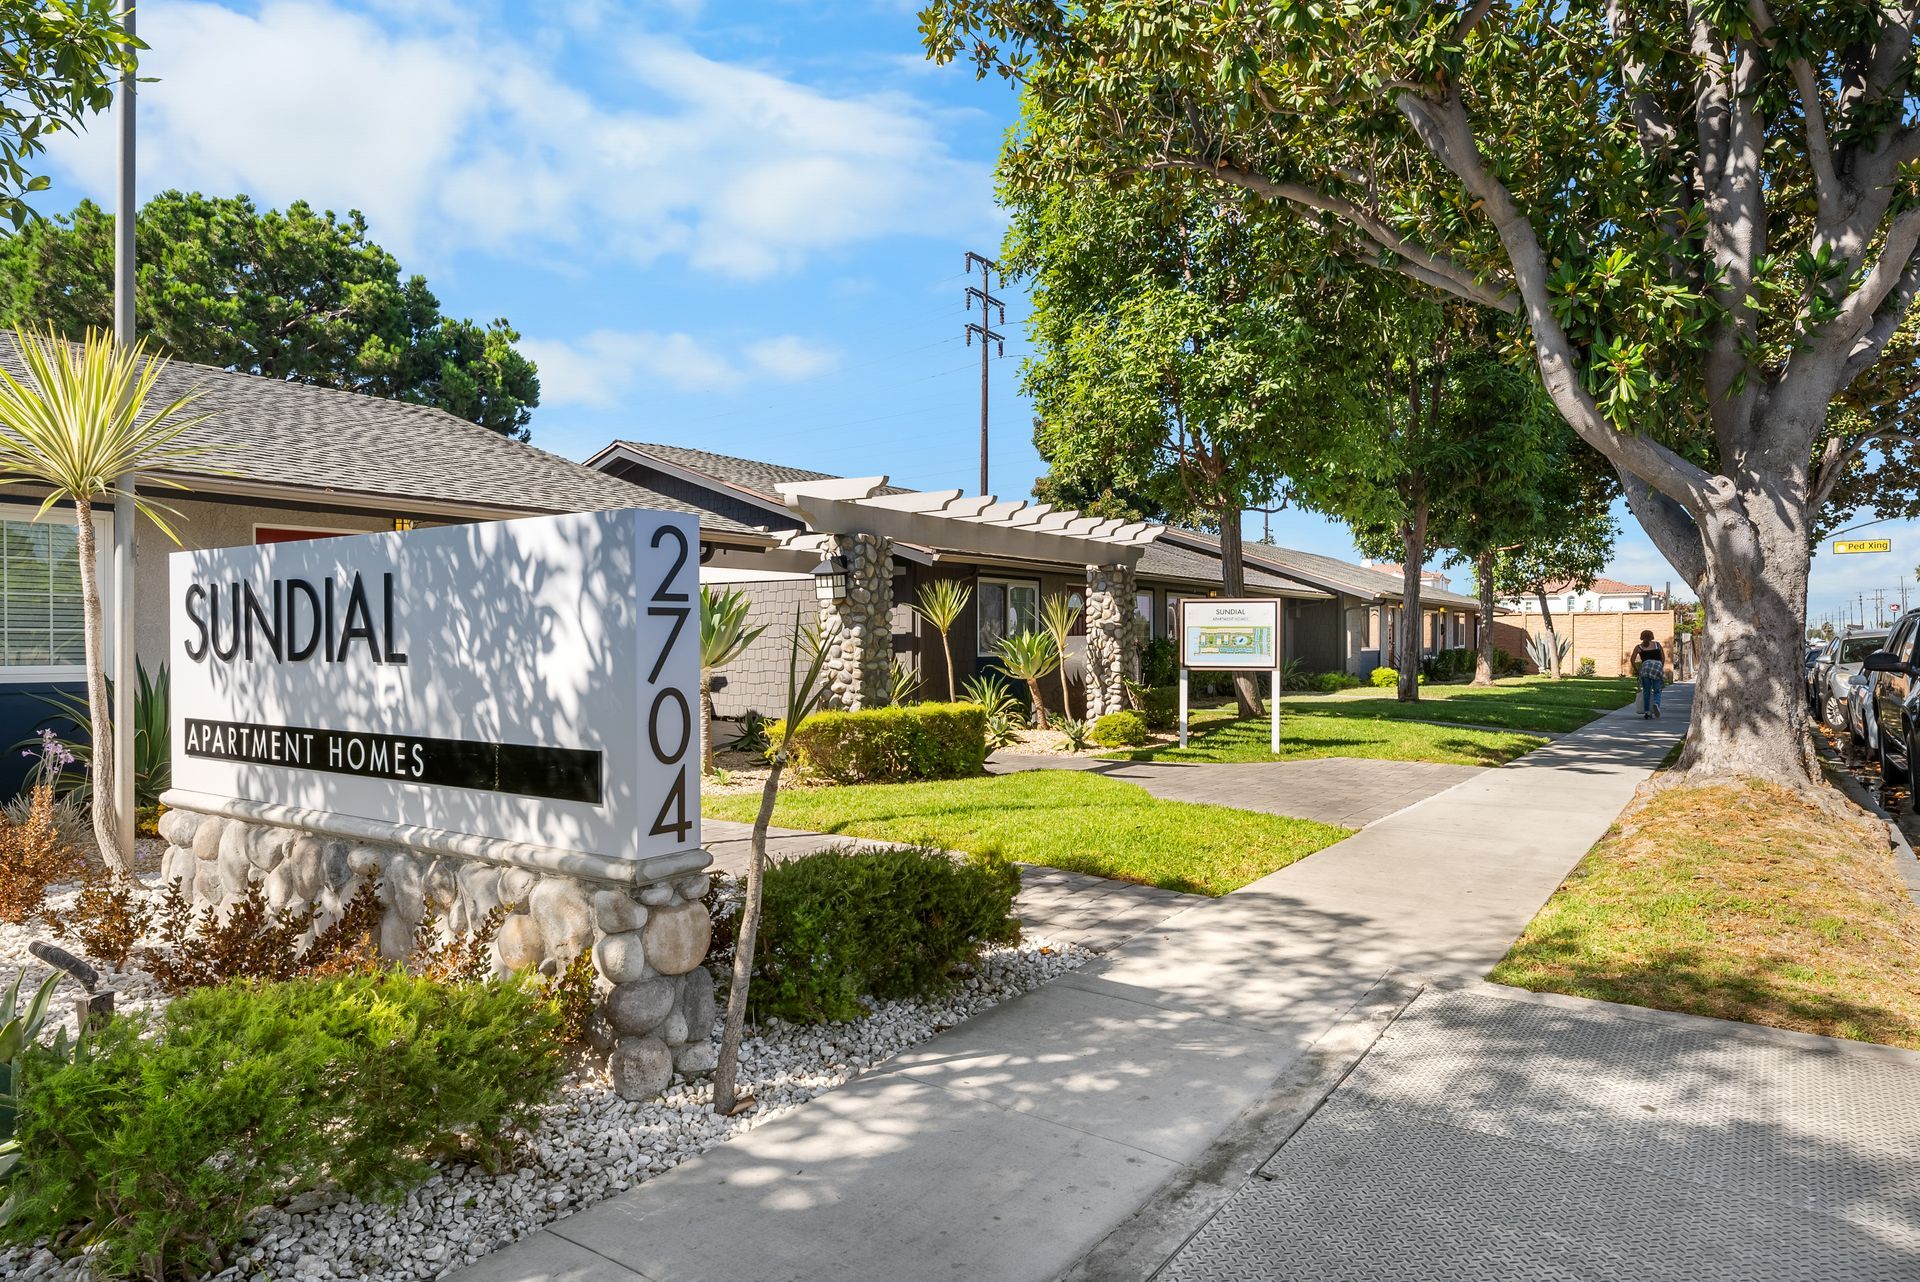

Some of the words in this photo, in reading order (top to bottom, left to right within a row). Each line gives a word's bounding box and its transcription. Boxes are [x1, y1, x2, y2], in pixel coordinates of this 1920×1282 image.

[1868, 542, 1888, 550] Xing
[184, 571, 408, 665] SUNDIAL
[647, 525, 693, 842] 2704
[187, 722, 315, 763] APARTMENT
[329, 737, 425, 777] HOMES
